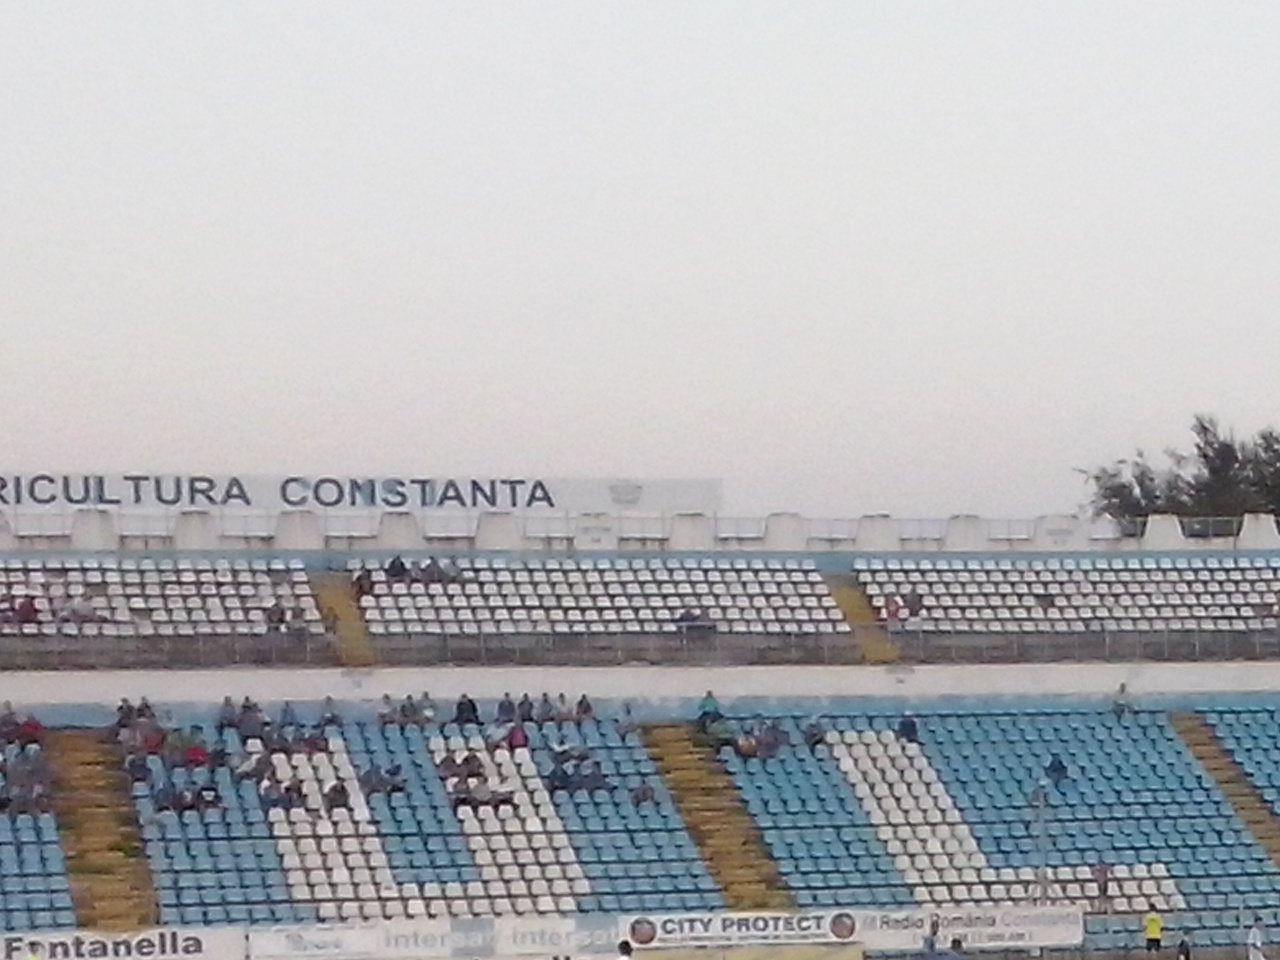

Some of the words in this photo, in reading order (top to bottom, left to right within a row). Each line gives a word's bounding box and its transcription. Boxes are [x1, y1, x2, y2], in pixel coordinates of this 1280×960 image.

[0, 474, 252, 506] ICULTURA
[279, 476, 555, 509] CONSTANTA
[660, 917, 713, 935] CITY
[721, 915, 825, 933] PROTECT
